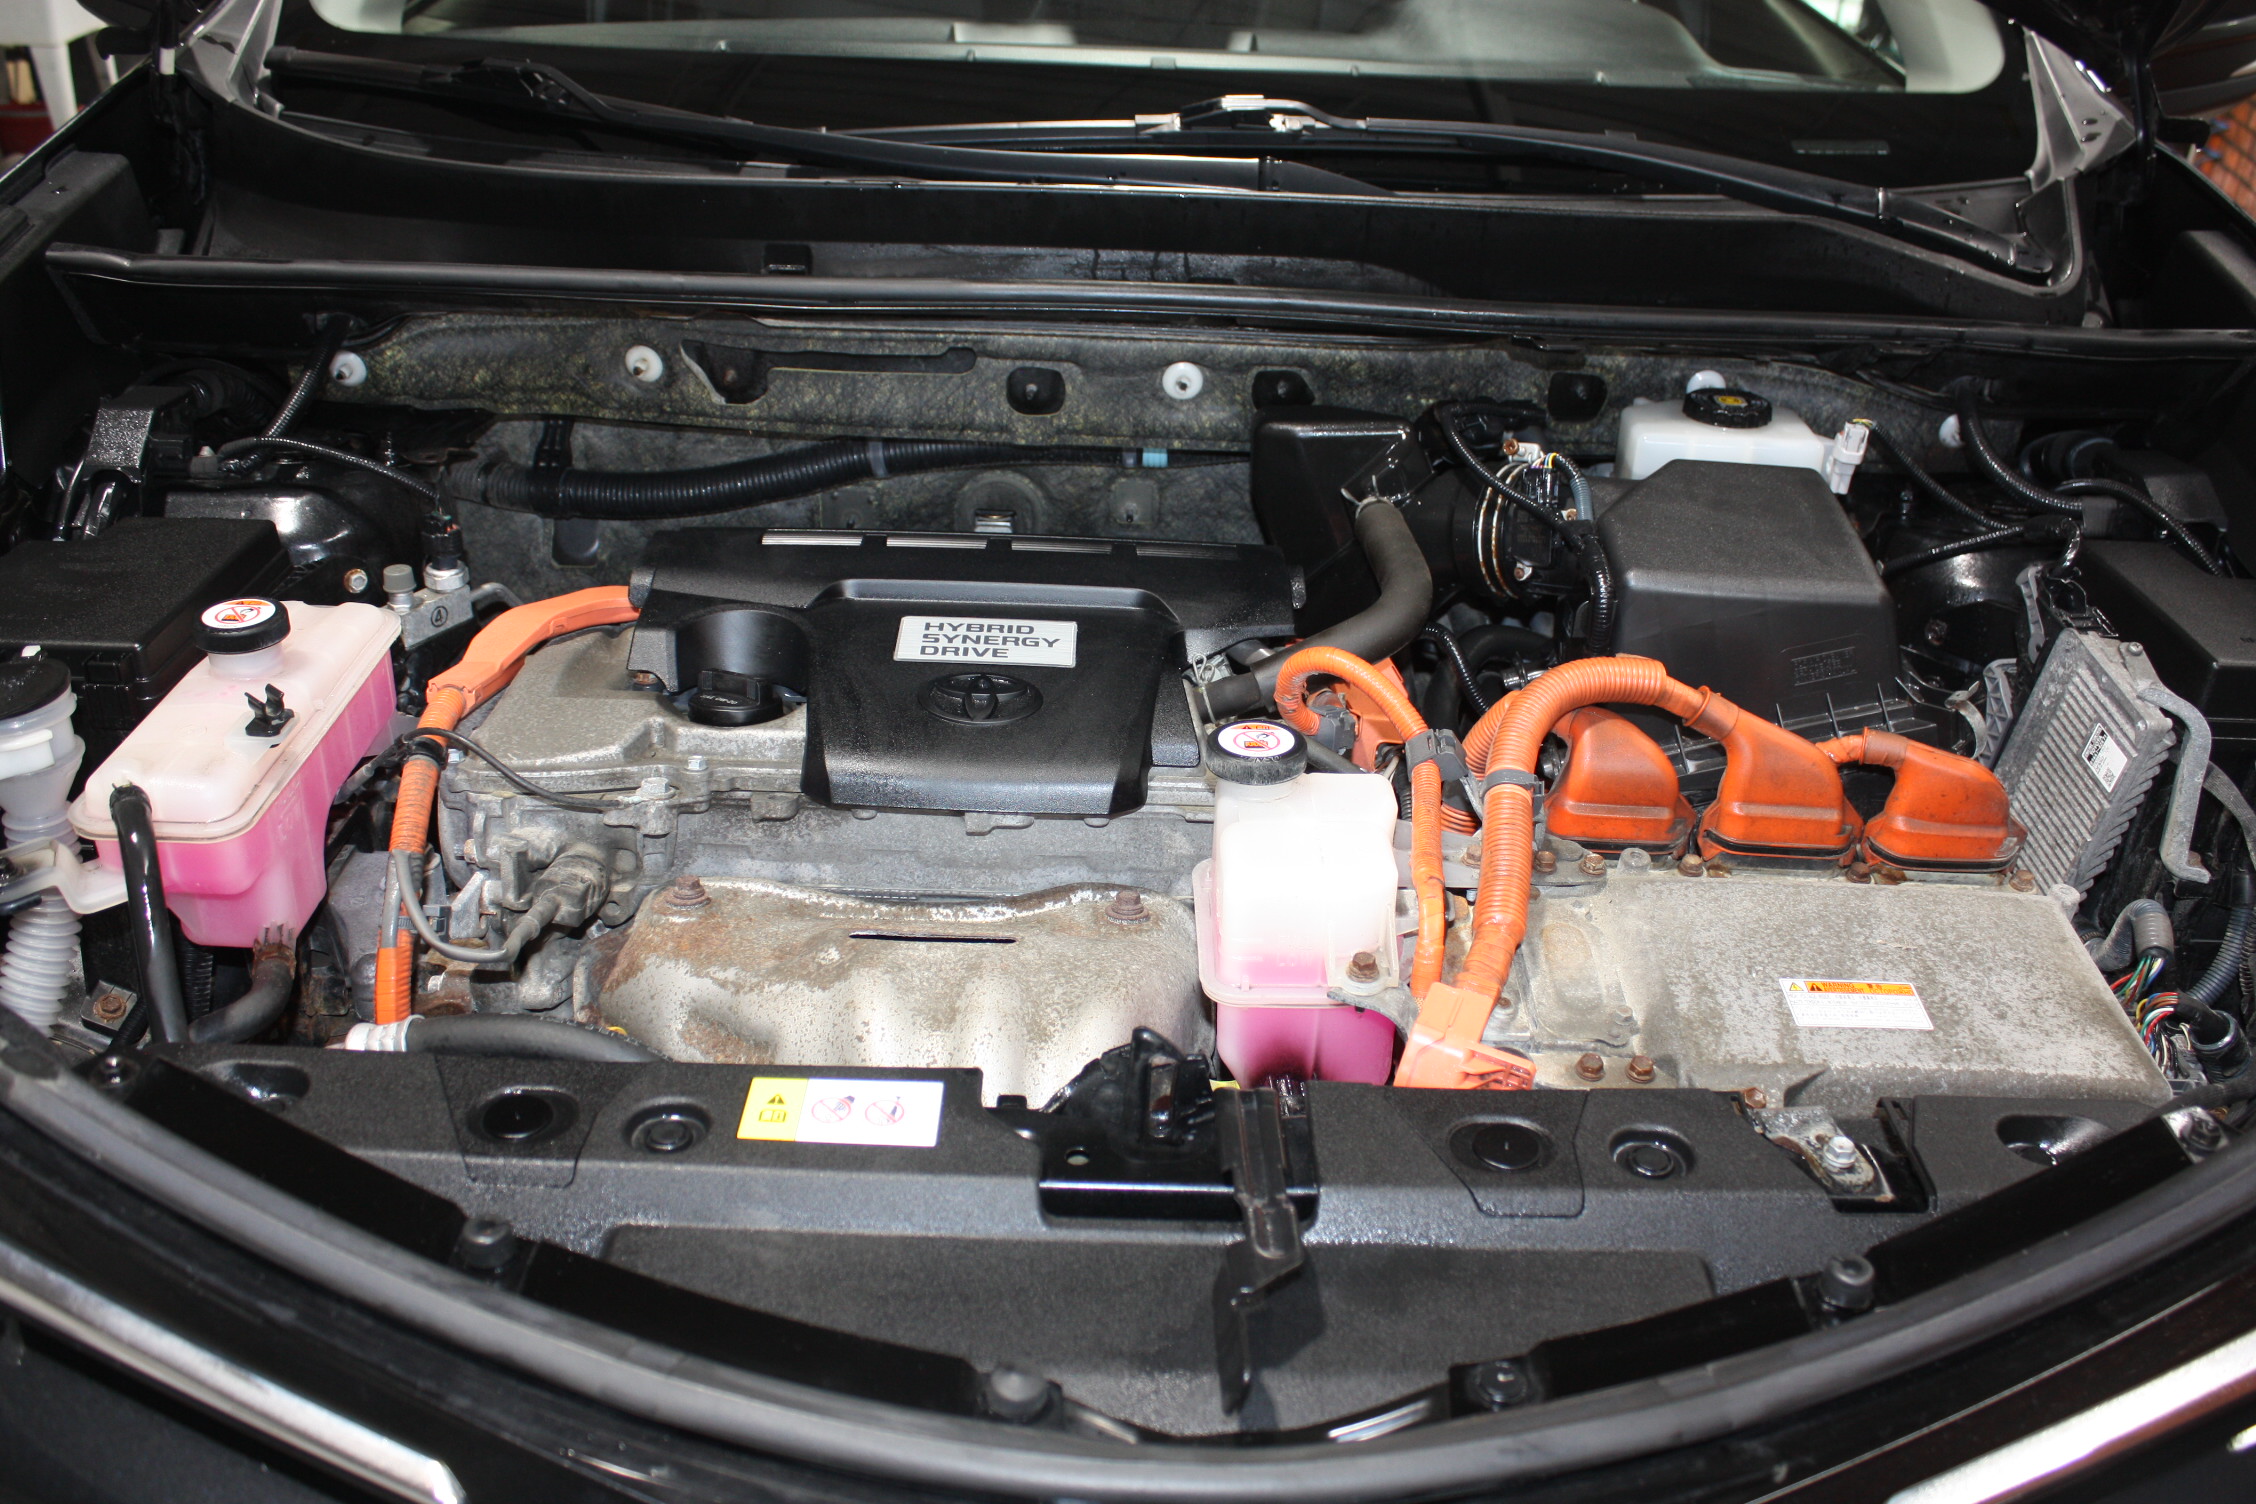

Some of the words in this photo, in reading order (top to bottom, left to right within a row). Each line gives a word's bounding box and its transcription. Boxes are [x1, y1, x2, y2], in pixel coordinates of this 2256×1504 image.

[924, 622, 1035, 635] HYBRID
[921, 633, 1061, 648] SYNERGY
[919, 645, 1010, 659] DRIVE
[1821, 981, 1855, 989] WARNING
